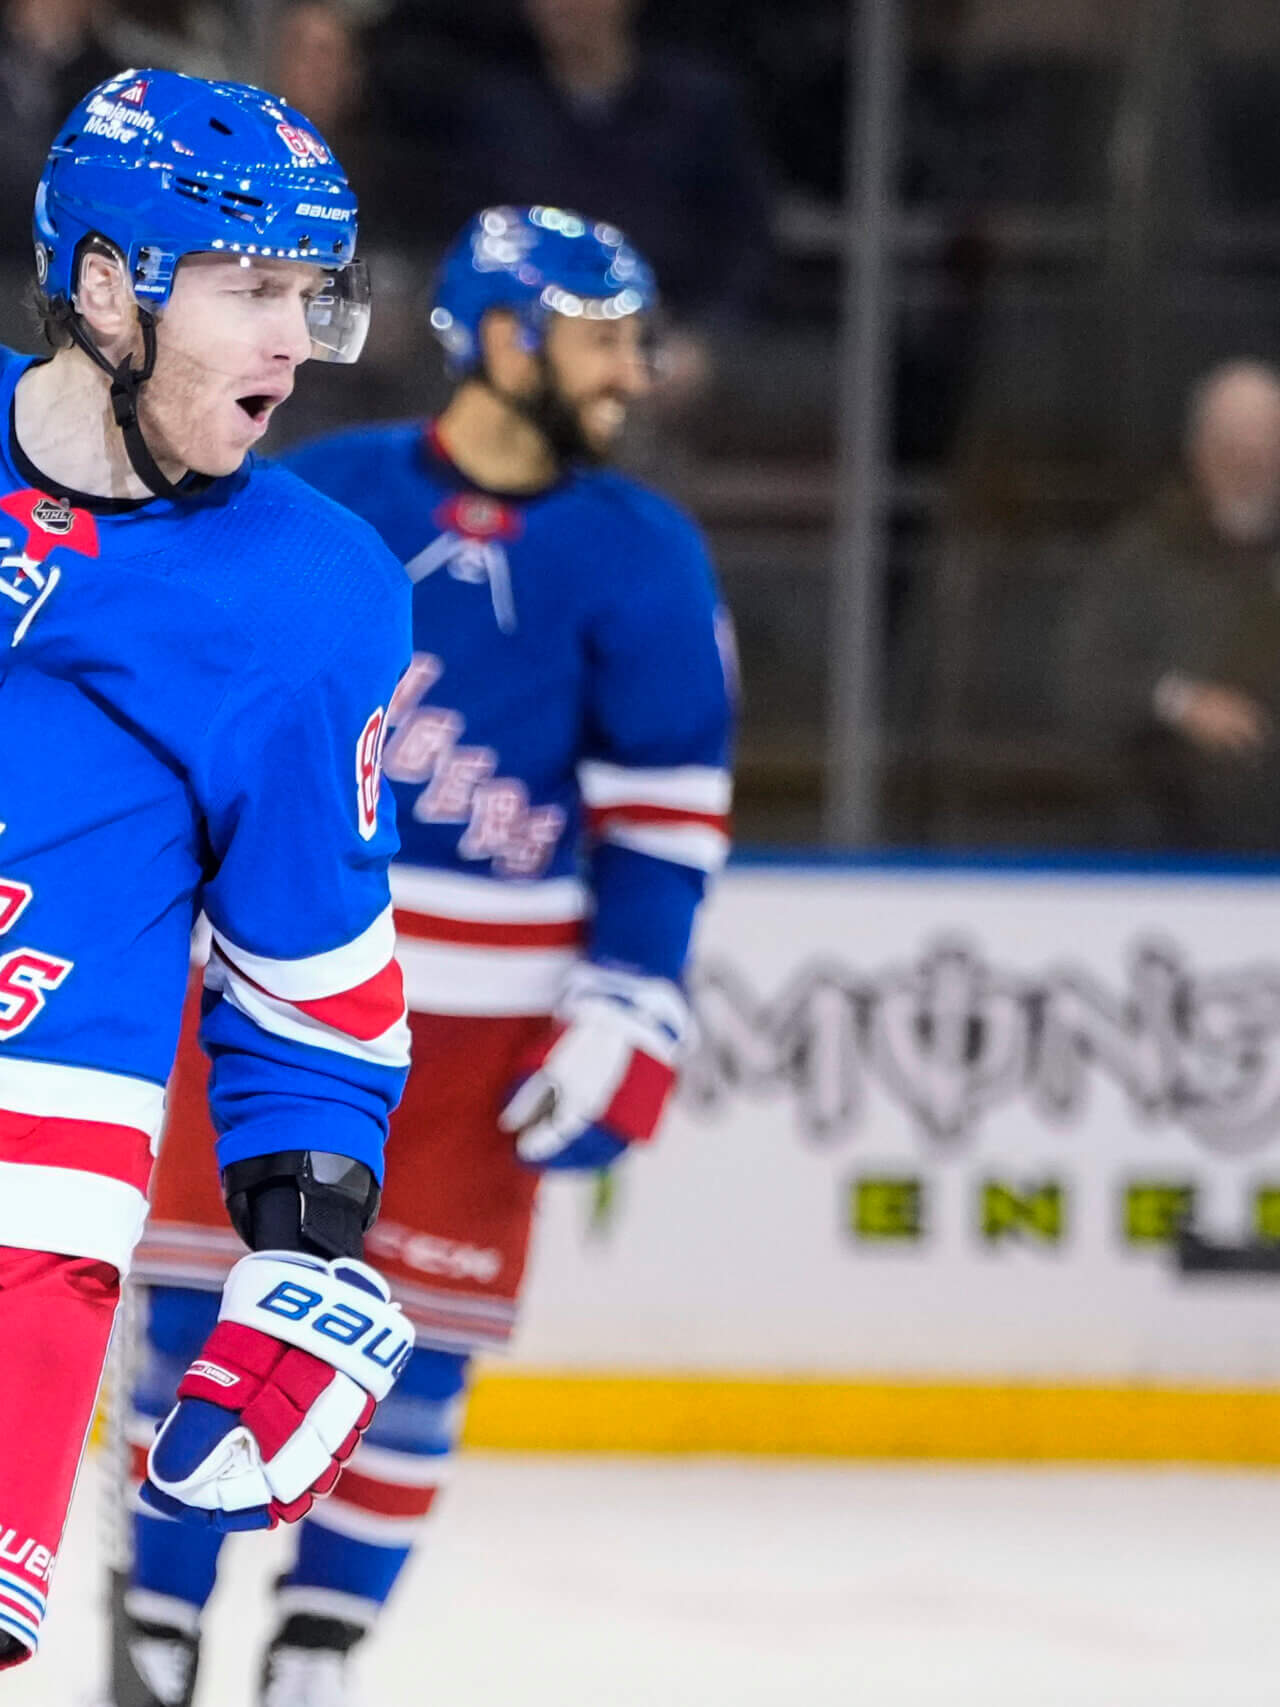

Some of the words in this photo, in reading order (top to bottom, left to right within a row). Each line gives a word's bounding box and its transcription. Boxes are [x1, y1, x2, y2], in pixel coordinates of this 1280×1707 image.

[83, 115, 136, 144] Moore
[86, 94, 156, 132] Benjamin
[39, 510, 68, 520] NHL
[355, 705, 383, 841] 8
